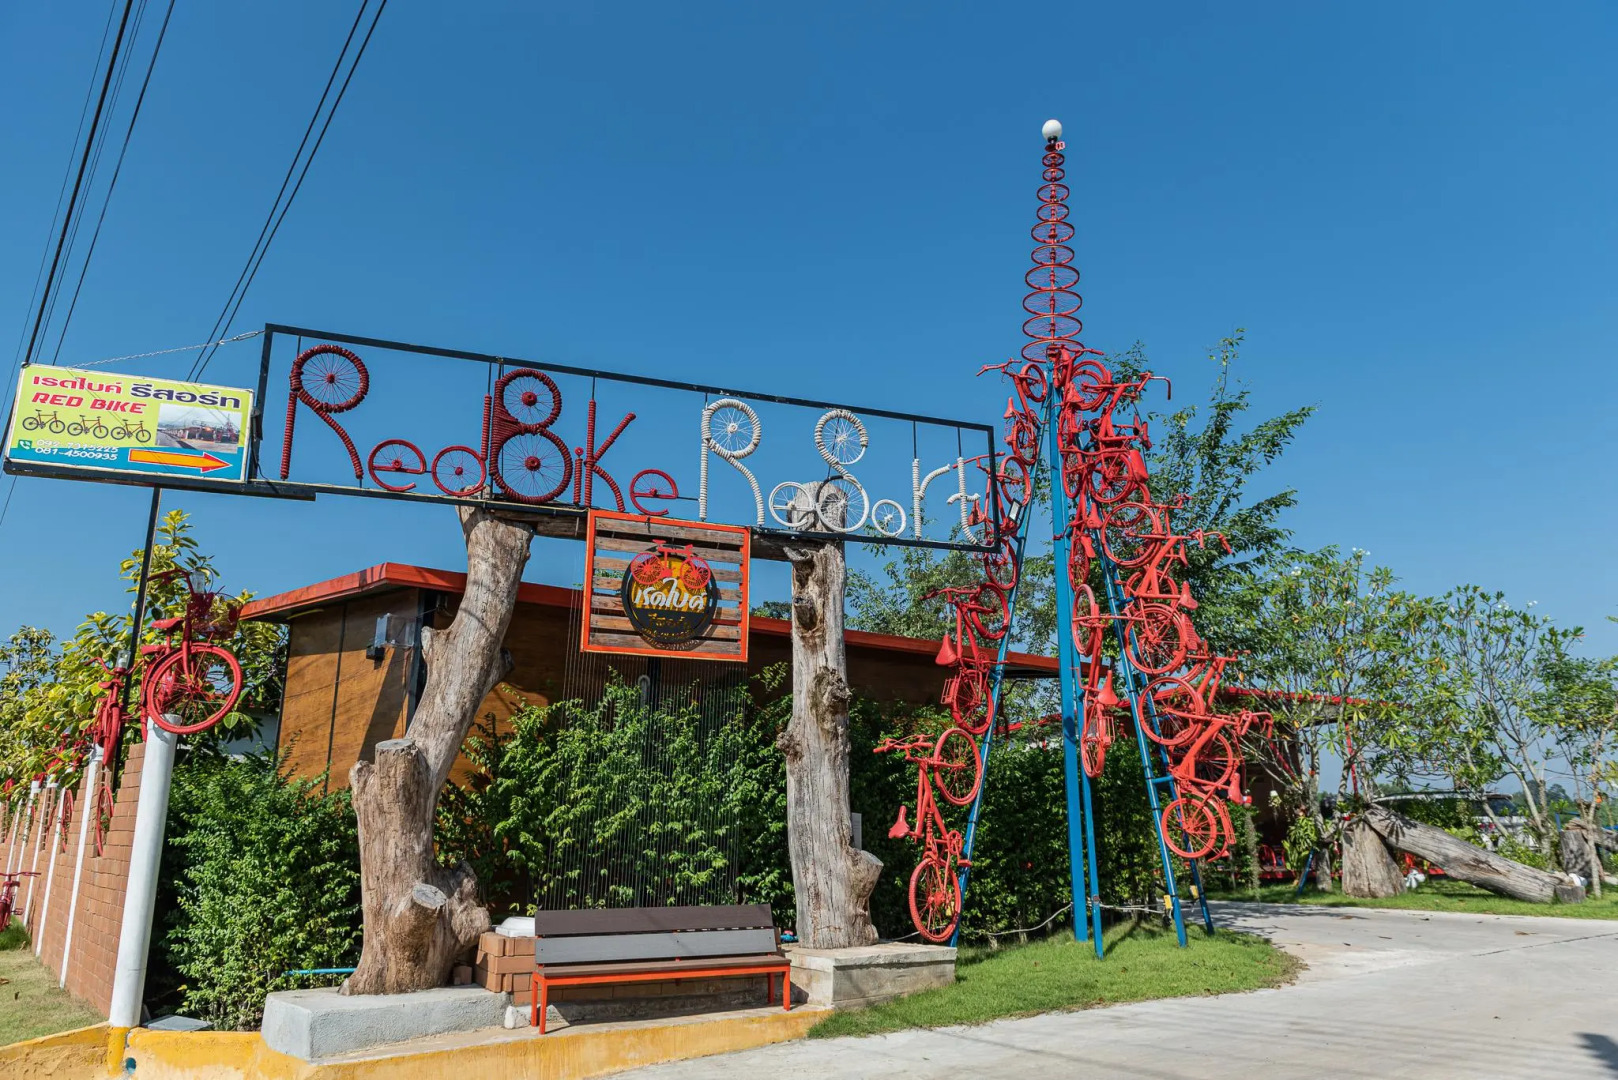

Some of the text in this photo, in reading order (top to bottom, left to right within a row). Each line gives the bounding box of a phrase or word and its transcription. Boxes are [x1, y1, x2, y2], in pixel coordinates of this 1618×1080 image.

[32, 392, 147, 414] RED BIKE
[33, 376, 240, 409] เรดไบค์ รีสอร์ท
